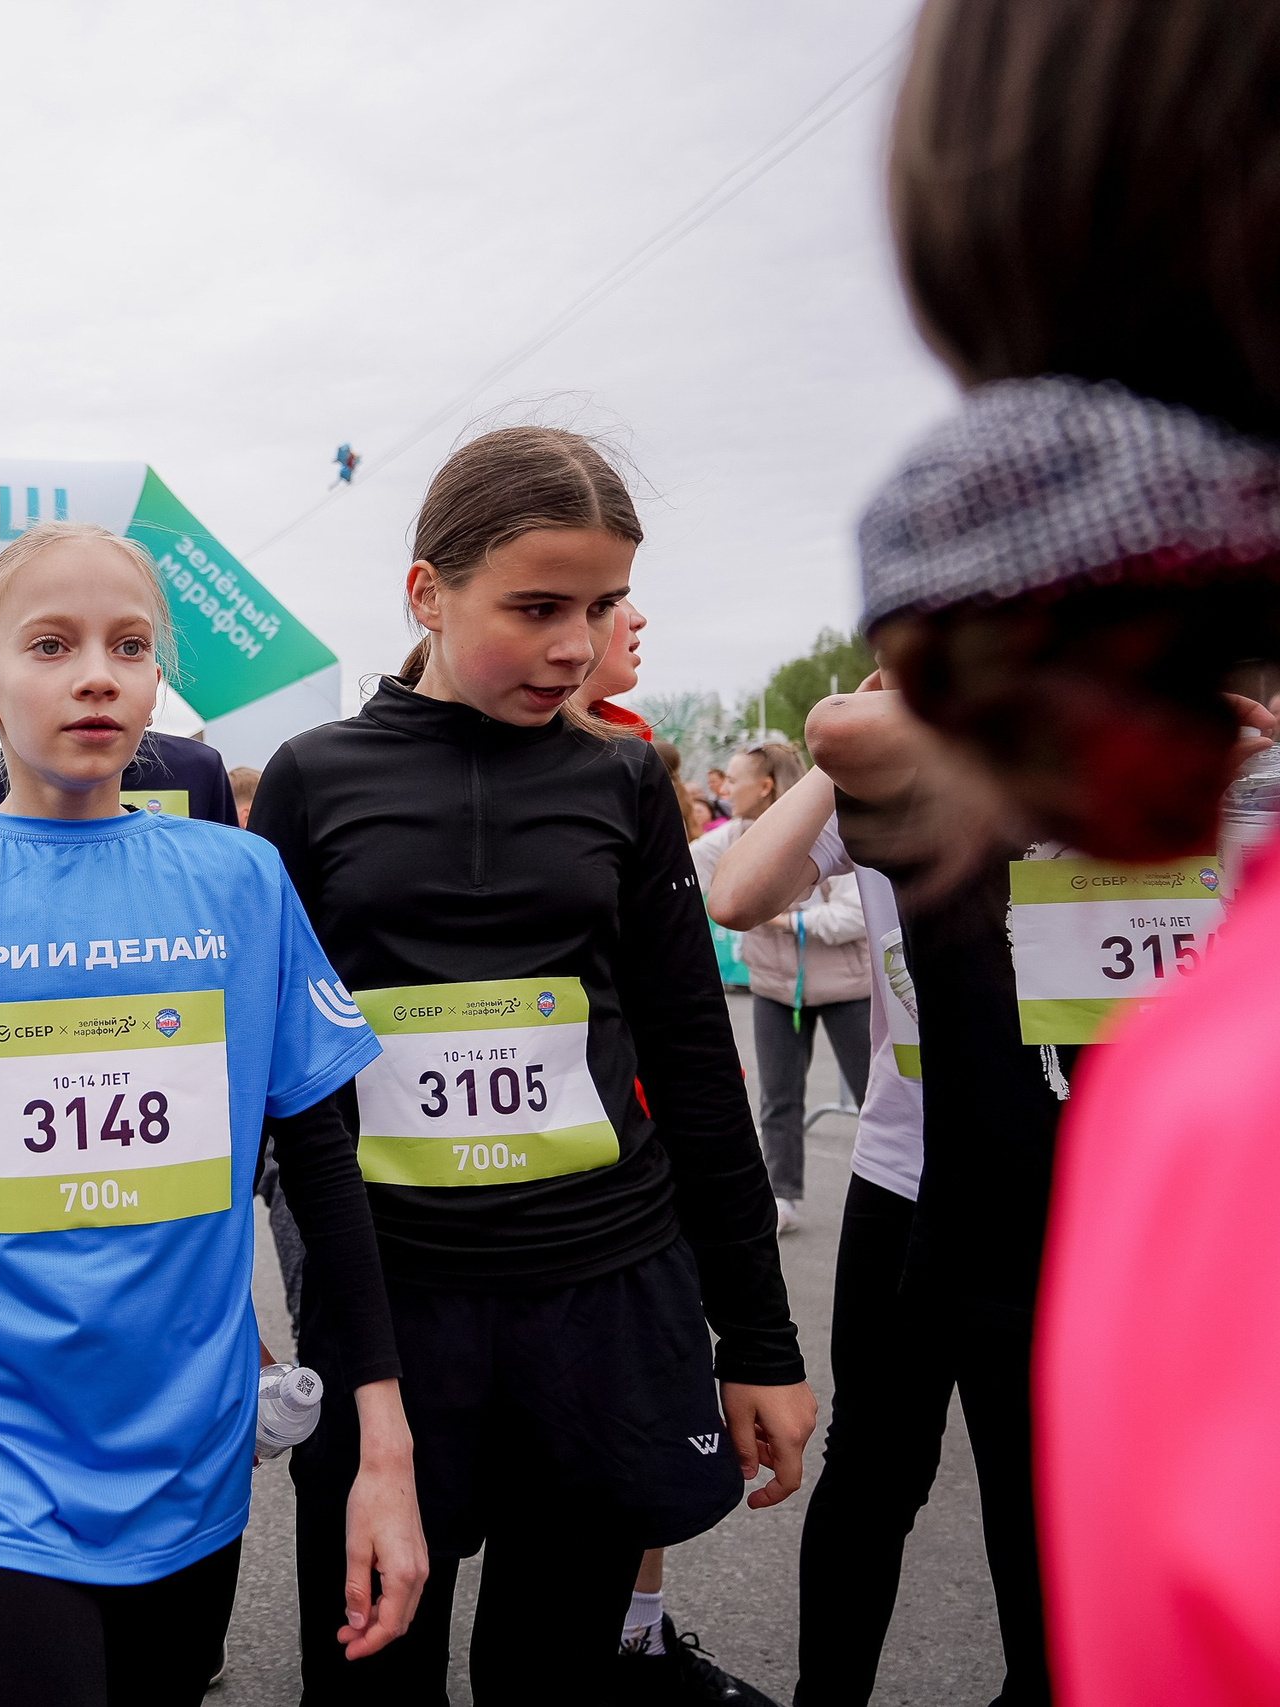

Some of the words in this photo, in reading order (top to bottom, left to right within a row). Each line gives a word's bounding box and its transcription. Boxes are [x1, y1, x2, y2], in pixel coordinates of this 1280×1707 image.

[174, 536, 281, 640] зелёный
[159, 553, 263, 660] марафон
[1091, 875, 1128, 888] СБЕР
[1129, 918, 1167, 929] 10-14
[1169, 916, 1192, 927] ЛЕТ
[48, 942, 77, 967] И
[85, 928, 227, 971] ДЕЛАЙ!
[465, 998, 503, 1009] зелёный
[410, 1006, 443, 1018] СБЕР
[461, 1007, 500, 1017] марафон
[78, 1016, 117, 1028] зелёный
[14, 1025, 54, 1039] СБЕР
[73, 1027, 114, 1038] марафон
[443, 1049, 483, 1063] 10-14
[489, 1047, 518, 1061] ЛЕТ
[52, 1074, 96, 1090] 10-14
[100, 1071, 131, 1087] ЛЕТ
[418, 1064, 548, 1118] 3105
[22, 1090, 171, 1154] 3148
